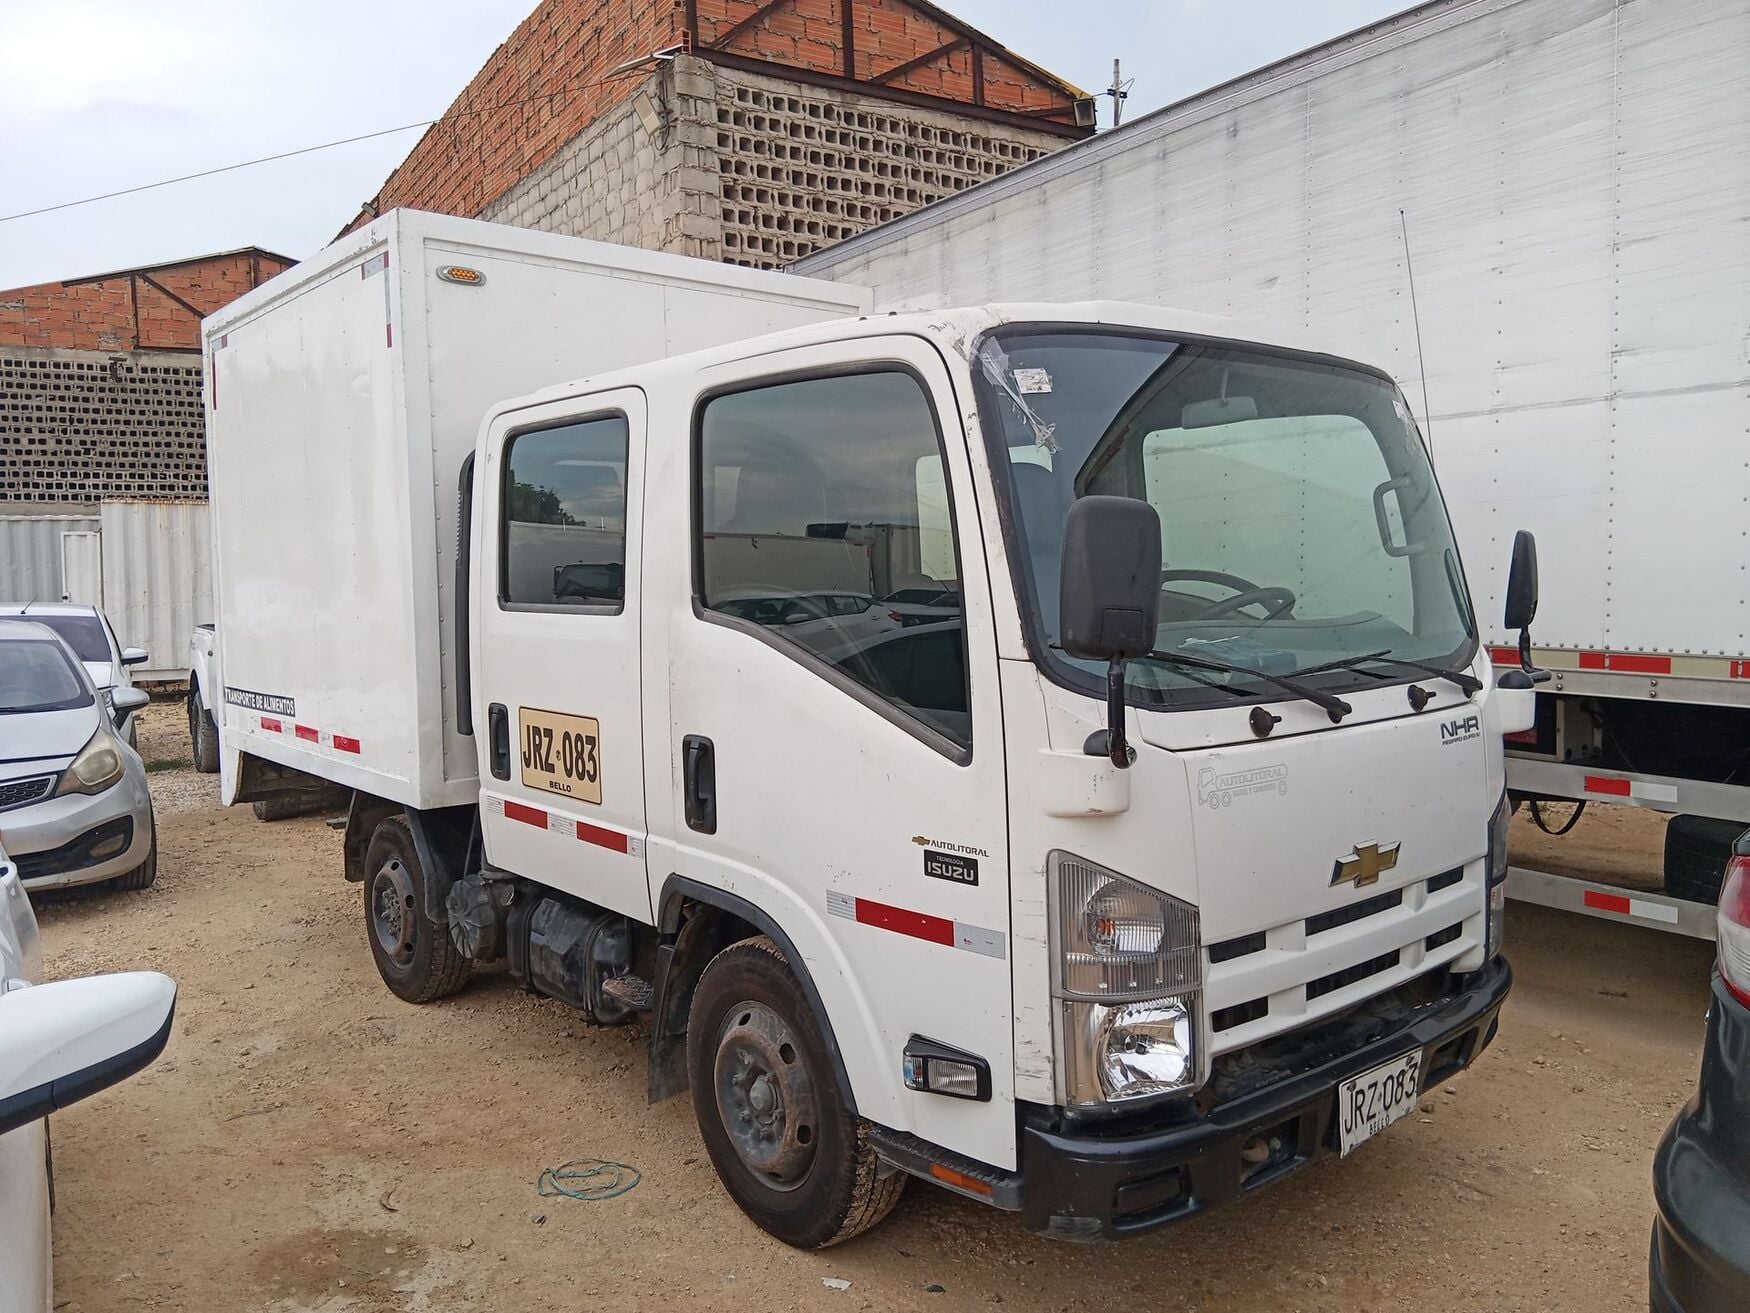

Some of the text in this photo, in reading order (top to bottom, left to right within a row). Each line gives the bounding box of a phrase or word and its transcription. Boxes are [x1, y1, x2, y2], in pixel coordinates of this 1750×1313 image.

[224, 688, 294, 715] TRANSPORTE DE ALIMENTOS
[1440, 715, 1479, 739] NHR
[549, 780, 571, 793] BELLO
[1219, 767, 1284, 787] AUTOLITORAL
[931, 840, 989, 857] AUTOLITORAL
[927, 861, 974, 881] ISUZU
[1369, 1114, 1390, 1135] BELLO
